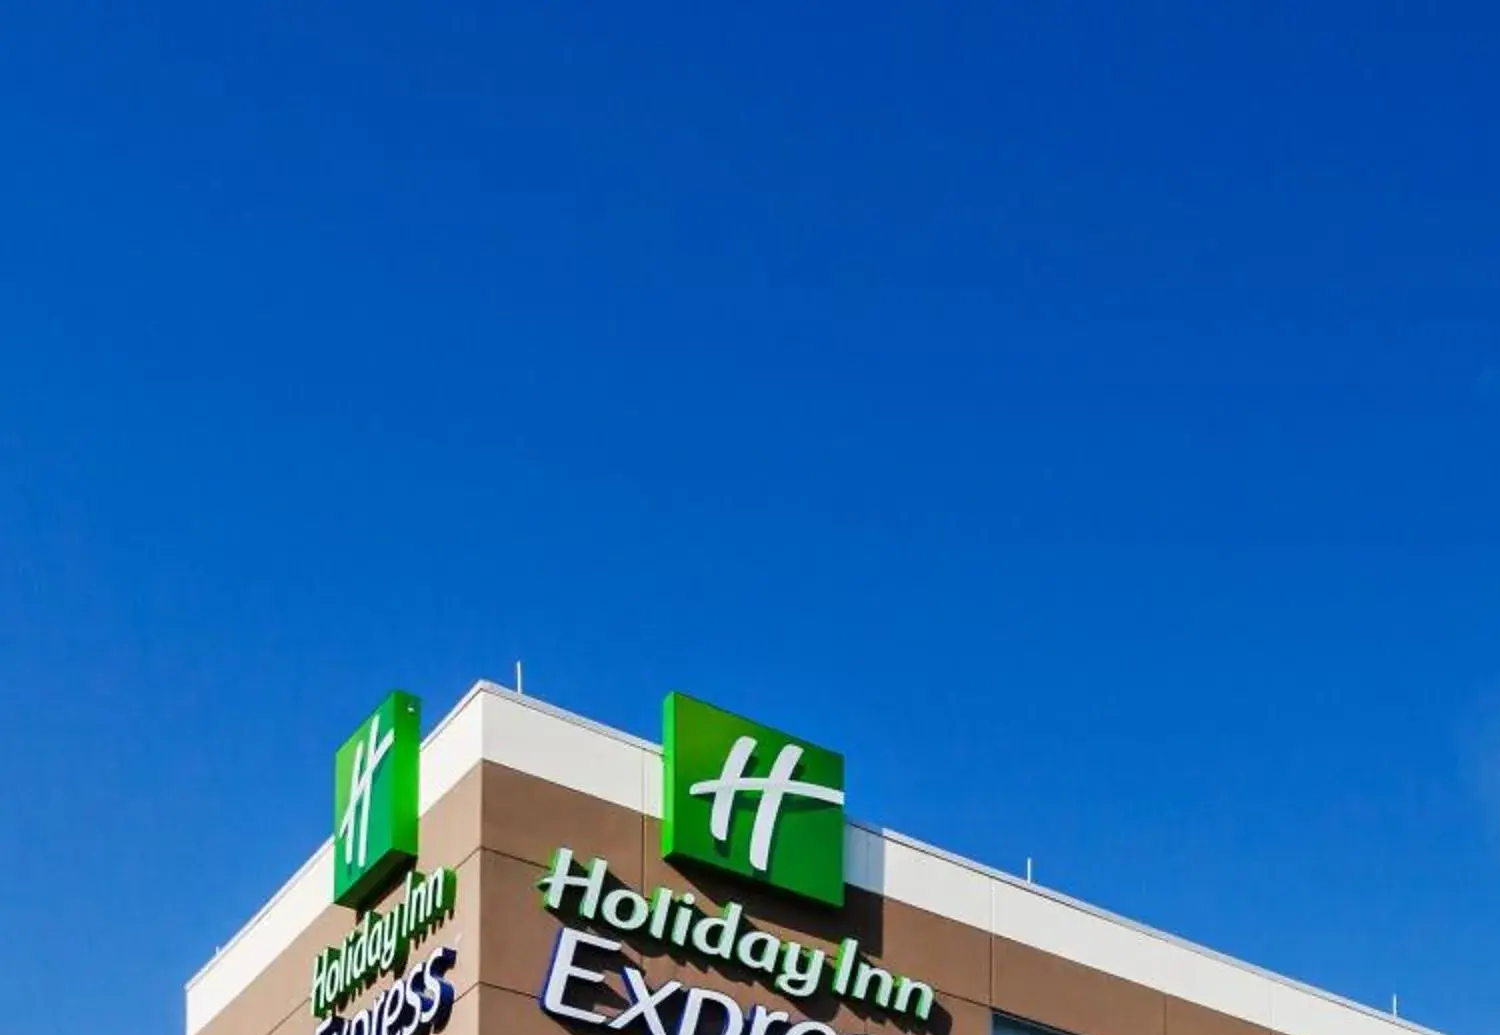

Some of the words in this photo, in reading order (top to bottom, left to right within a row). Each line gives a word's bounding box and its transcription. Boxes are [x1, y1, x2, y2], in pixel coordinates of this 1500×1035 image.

[311, 910, 400, 1015] Holiday
[402, 866, 447, 938] Inn
[537, 847, 825, 997] Holiday
[834, 937, 935, 1021] Inn
